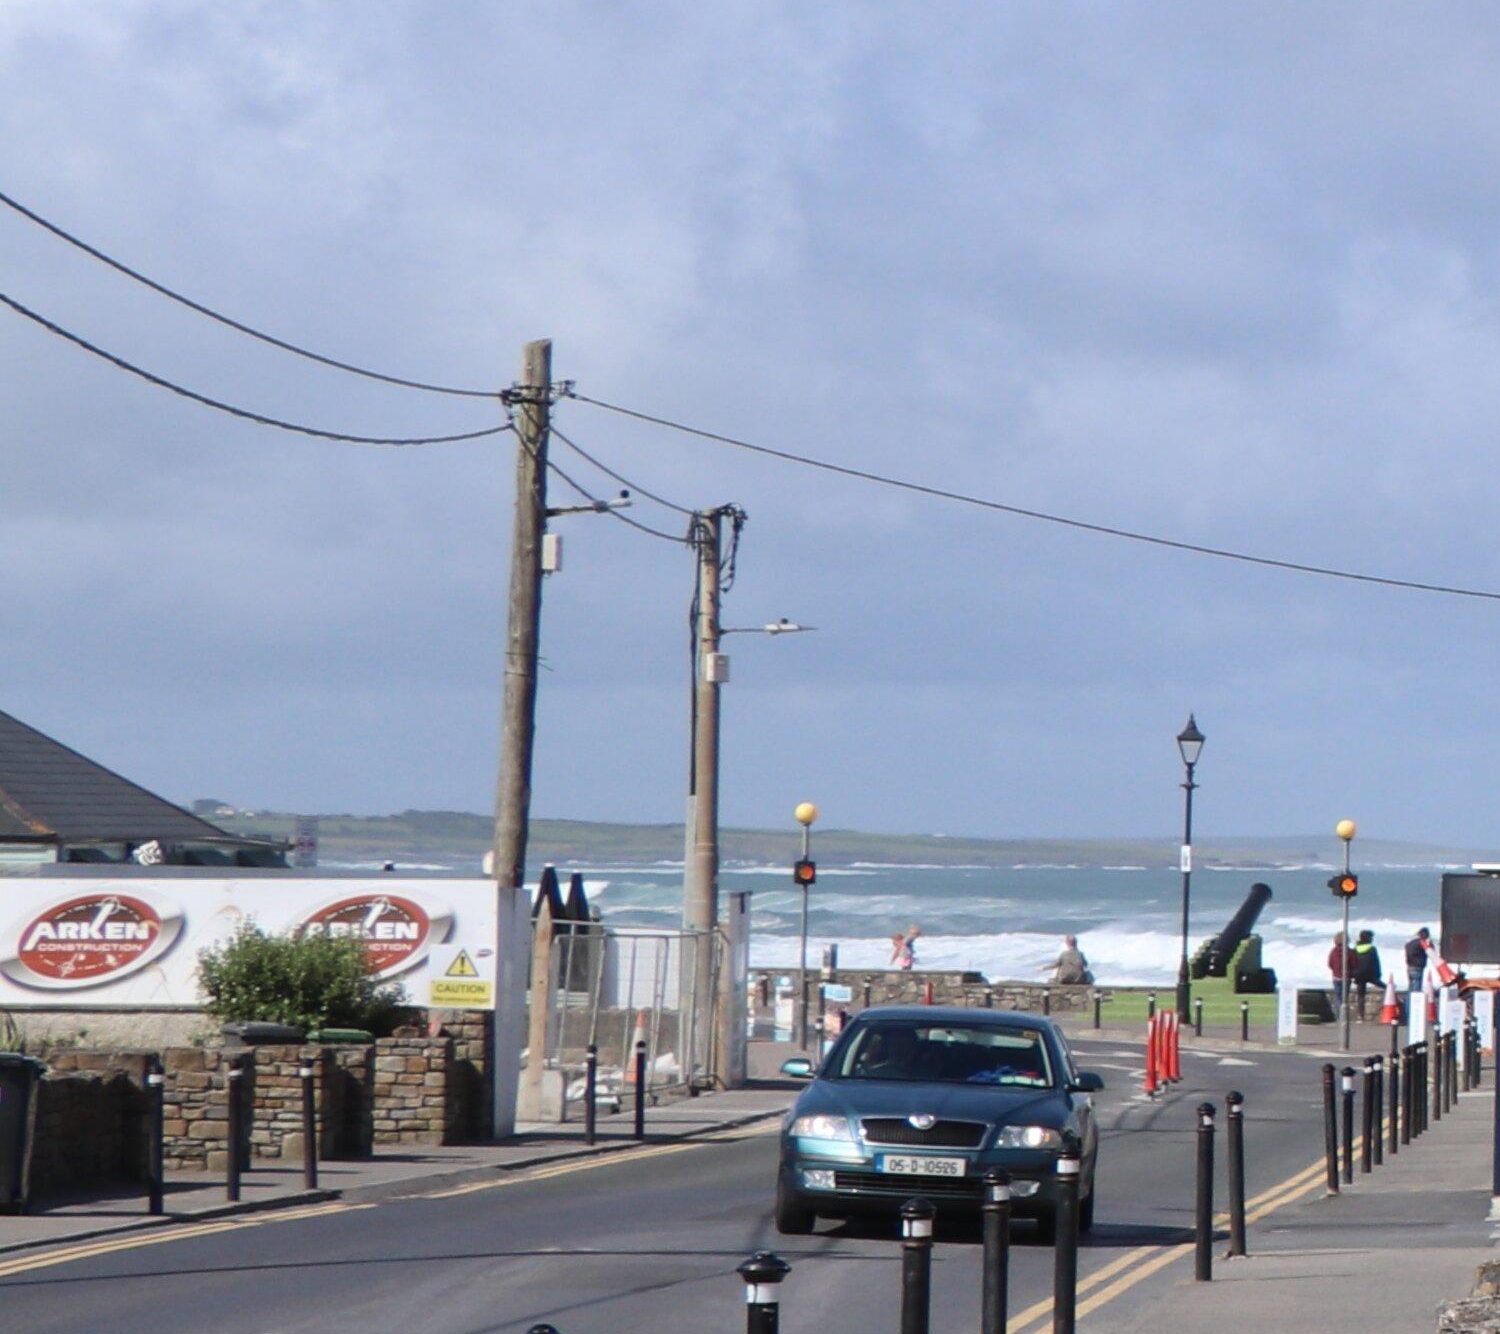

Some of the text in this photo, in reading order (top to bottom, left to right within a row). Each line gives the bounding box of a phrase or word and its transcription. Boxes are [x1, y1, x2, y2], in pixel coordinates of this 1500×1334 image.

[22, 903, 150, 952] ARKEN
[37, 942, 144, 952] CONSTRUCTION
[435, 983, 487, 994] CAUTION
